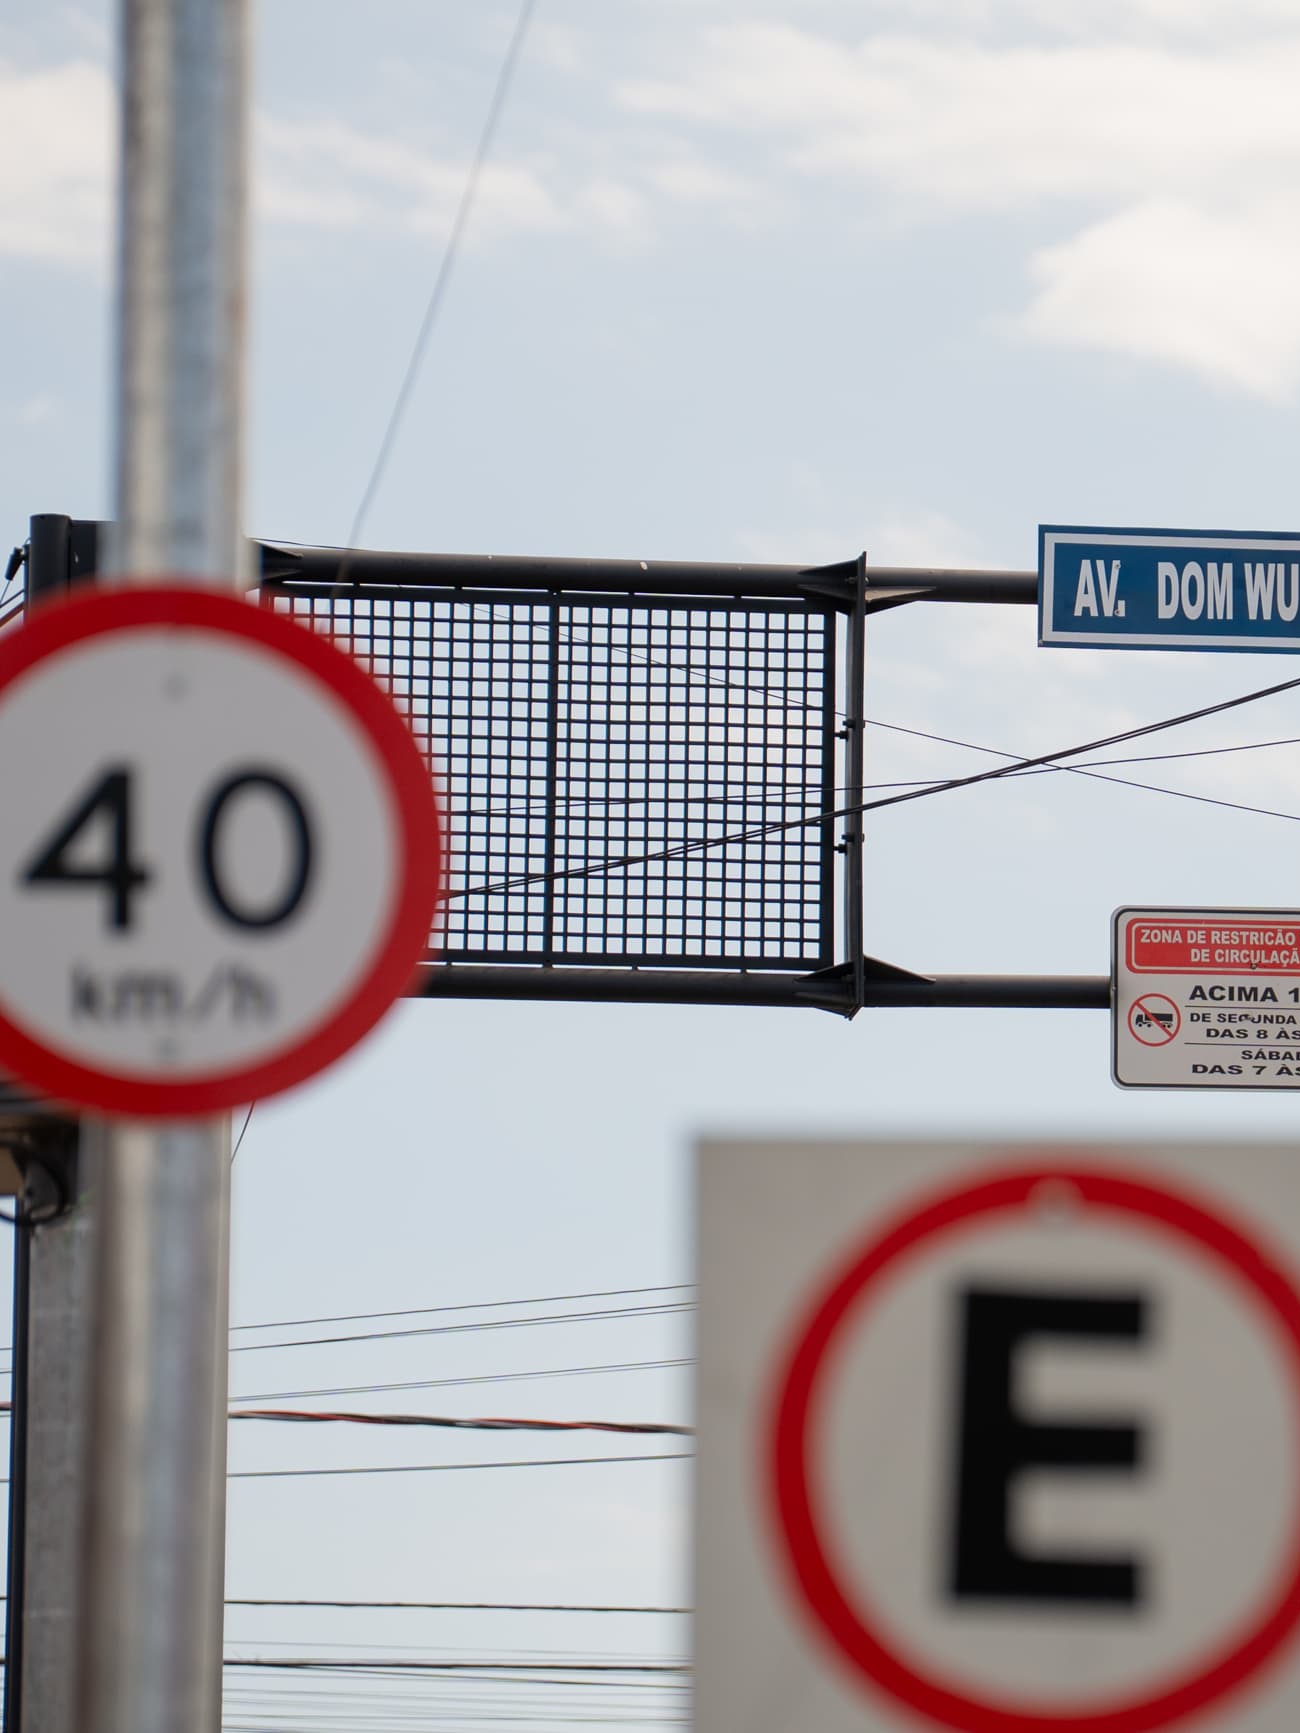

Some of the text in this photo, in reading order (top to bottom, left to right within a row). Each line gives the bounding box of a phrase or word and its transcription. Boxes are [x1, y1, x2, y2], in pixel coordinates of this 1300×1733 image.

[1073, 559, 1126, 617] AV.
[1157, 561, 1233, 620] DOM
[20, 763, 315, 935] 40
[1140, 929, 1182, 943] ZONA
[1187, 930, 1206, 944] DE
[1190, 948, 1210, 962] DE
[71, 962, 276, 1022] km/h
[1189, 985, 1279, 1002] ACIMA
[1190, 1013, 1211, 1022] DE
[1206, 1028, 1248, 1039] DAS
[1256, 1029, 1268, 1039] 8
[1192, 1064, 1243, 1075] DAS
[1252, 1065, 1267, 1075] 7
[945, 1282, 1155, 1612] E
